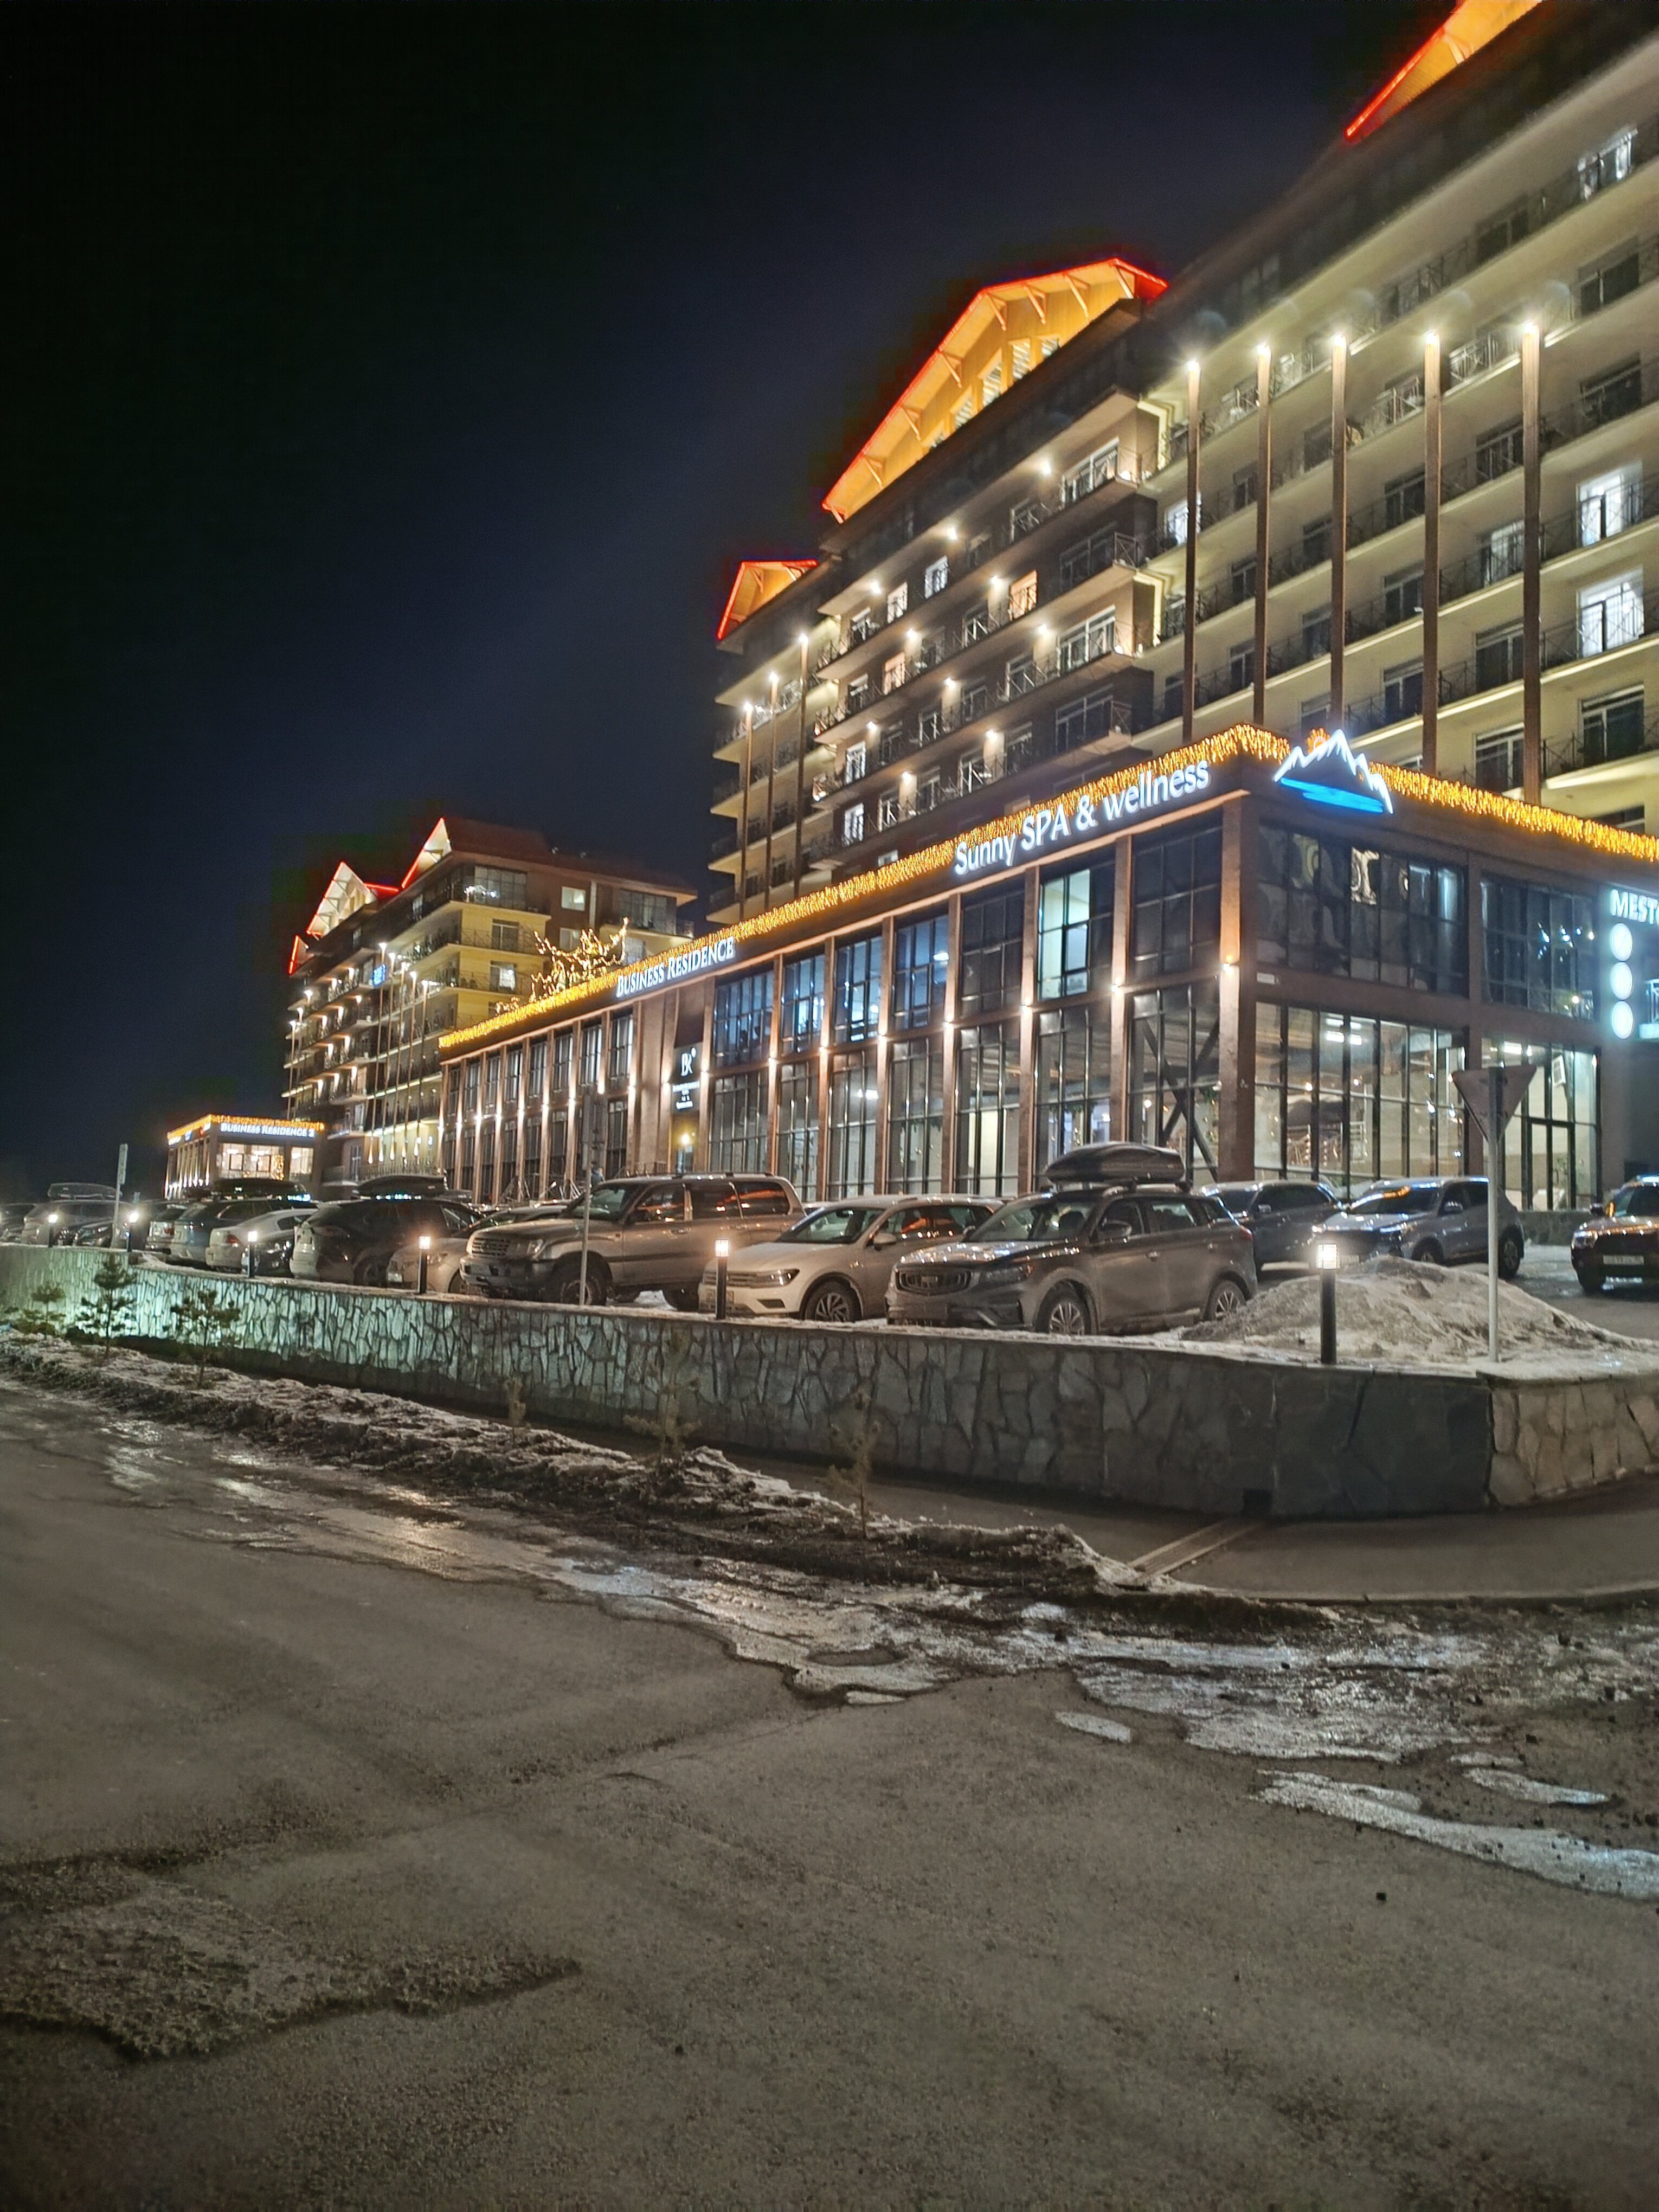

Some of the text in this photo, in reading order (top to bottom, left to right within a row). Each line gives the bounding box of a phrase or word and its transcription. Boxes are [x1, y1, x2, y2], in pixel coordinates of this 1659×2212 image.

[954, 760, 1211, 876] Sunny SPA & wellness
[616, 936, 736, 998] BUSINESS RESIDENCE
